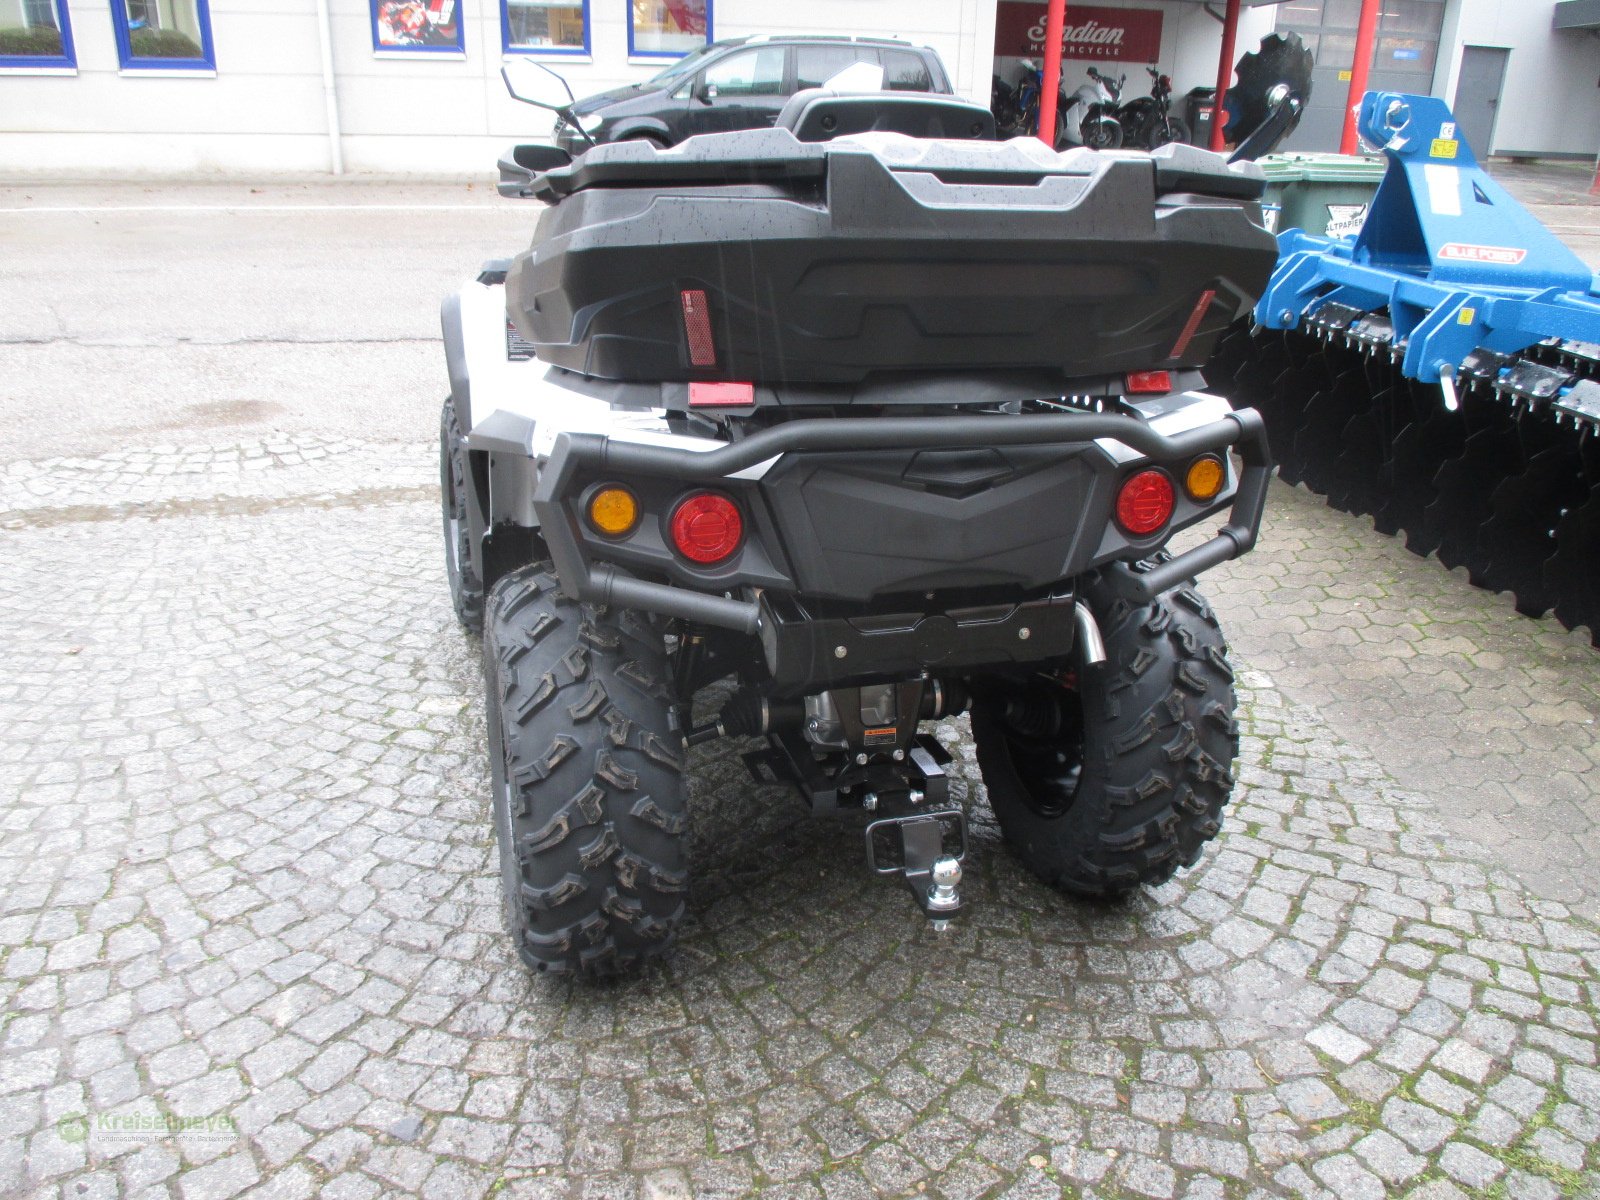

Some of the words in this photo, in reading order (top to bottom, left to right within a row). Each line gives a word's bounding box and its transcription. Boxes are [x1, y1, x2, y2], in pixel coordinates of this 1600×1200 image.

[1028, 12, 1125, 45] Indian
[1030, 44, 1120, 56] MOORCYCLE
[1325, 218, 1364, 231] ALTPAPIER
